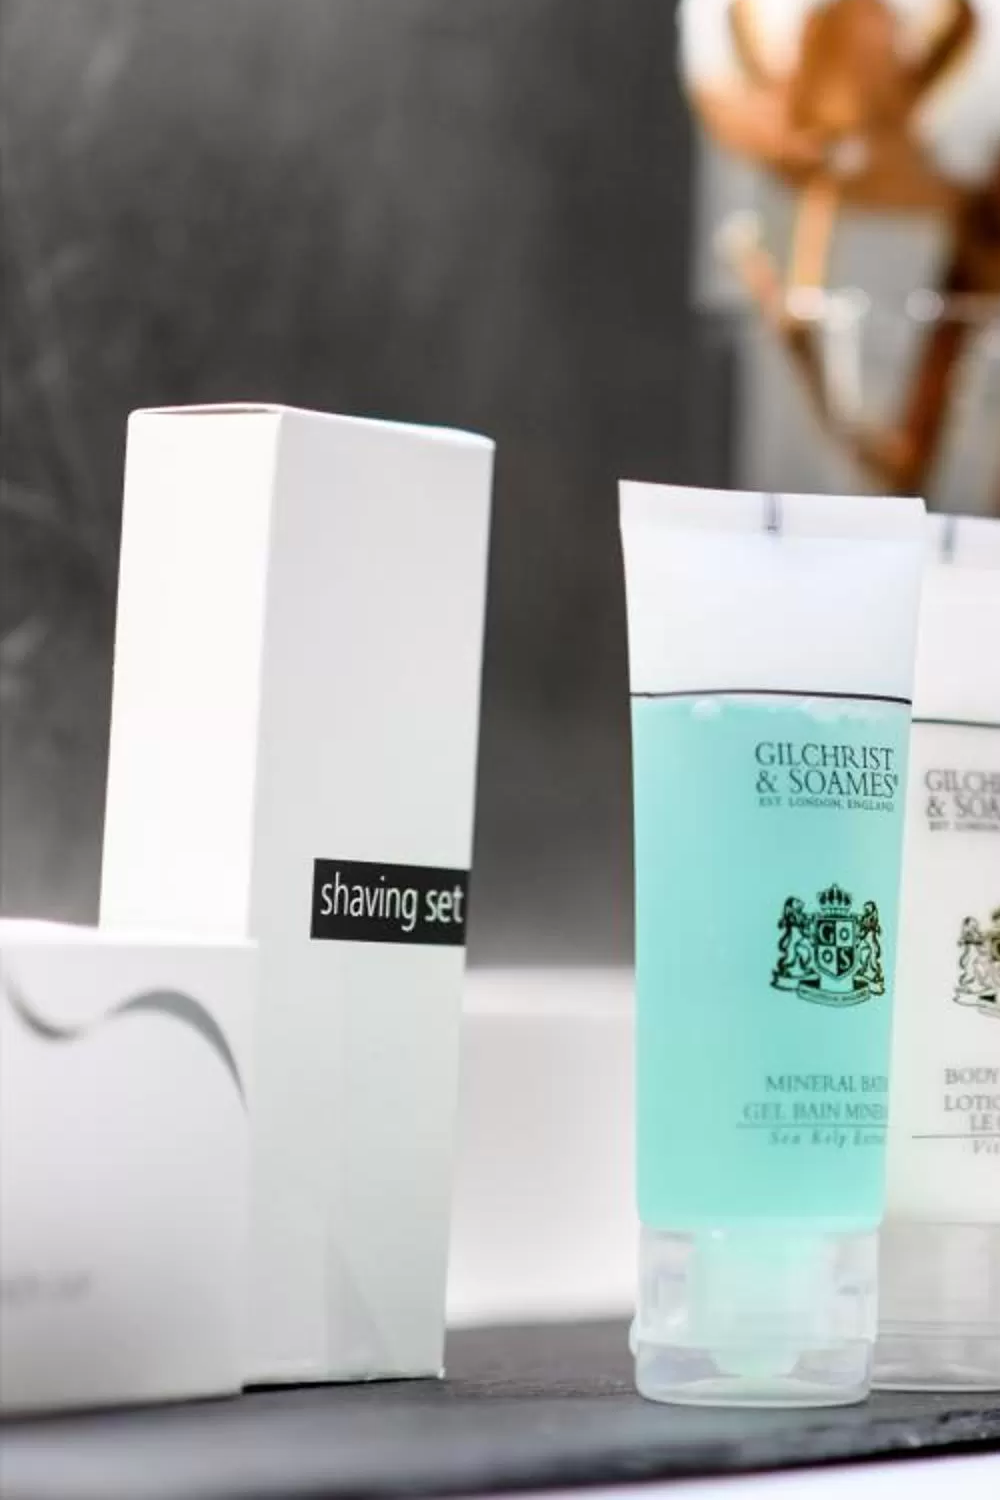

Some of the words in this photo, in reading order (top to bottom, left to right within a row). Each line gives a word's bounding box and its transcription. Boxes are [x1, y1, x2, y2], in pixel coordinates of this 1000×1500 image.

[755, 741, 895, 771] GILCHRIST
[755, 770, 778, 794] &
[925, 795, 946, 818] &
[319, 871, 418, 932] shaving
[424, 884, 465, 924] set
[765, 1074, 858, 1093] MINERAL
[943, 1067, 999, 1085] BODY
[742, 1102, 784, 1121] GEL
[792, 1102, 841, 1121] BAIN
[969, 1113, 993, 1131] LE
